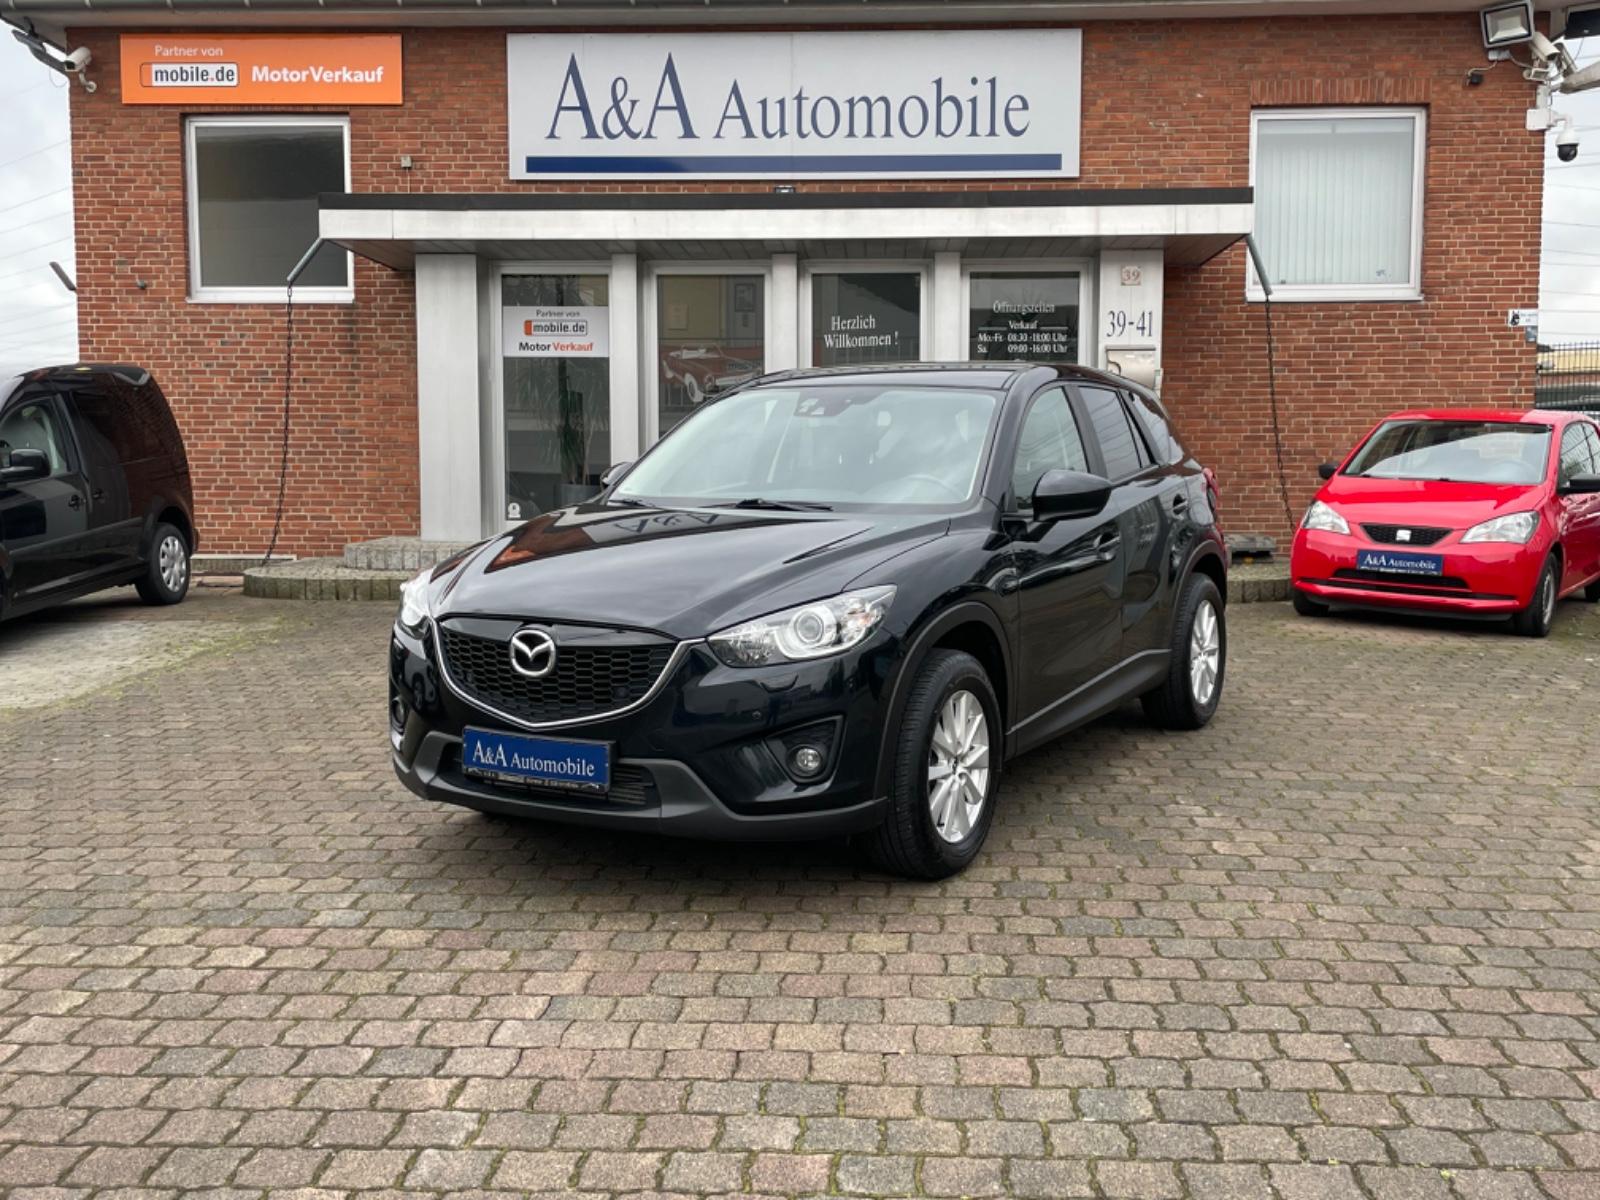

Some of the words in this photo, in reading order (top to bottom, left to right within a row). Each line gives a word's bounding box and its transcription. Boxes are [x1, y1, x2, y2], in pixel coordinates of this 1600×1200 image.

[154, 45, 198, 57] Partner
[201, 46, 223, 57] von
[154, 66, 235, 82] mobile.de
[545, 52, 700, 140] A&A
[714, 76, 1031, 139] Automobile
[1124, 269, 1140, 281] 39
[533, 323, 585, 333] mobile.de
[831, 314, 876, 331] Herzlich
[824, 333, 892, 348] Willkommen
[1053, 333, 1067, 342] Uhr
[1053, 344, 1067, 353] Uhr
[1388, 558, 1436, 569] Automobile
[472, 739, 507, 767] A&A
[510, 753, 595, 776] Automobile
